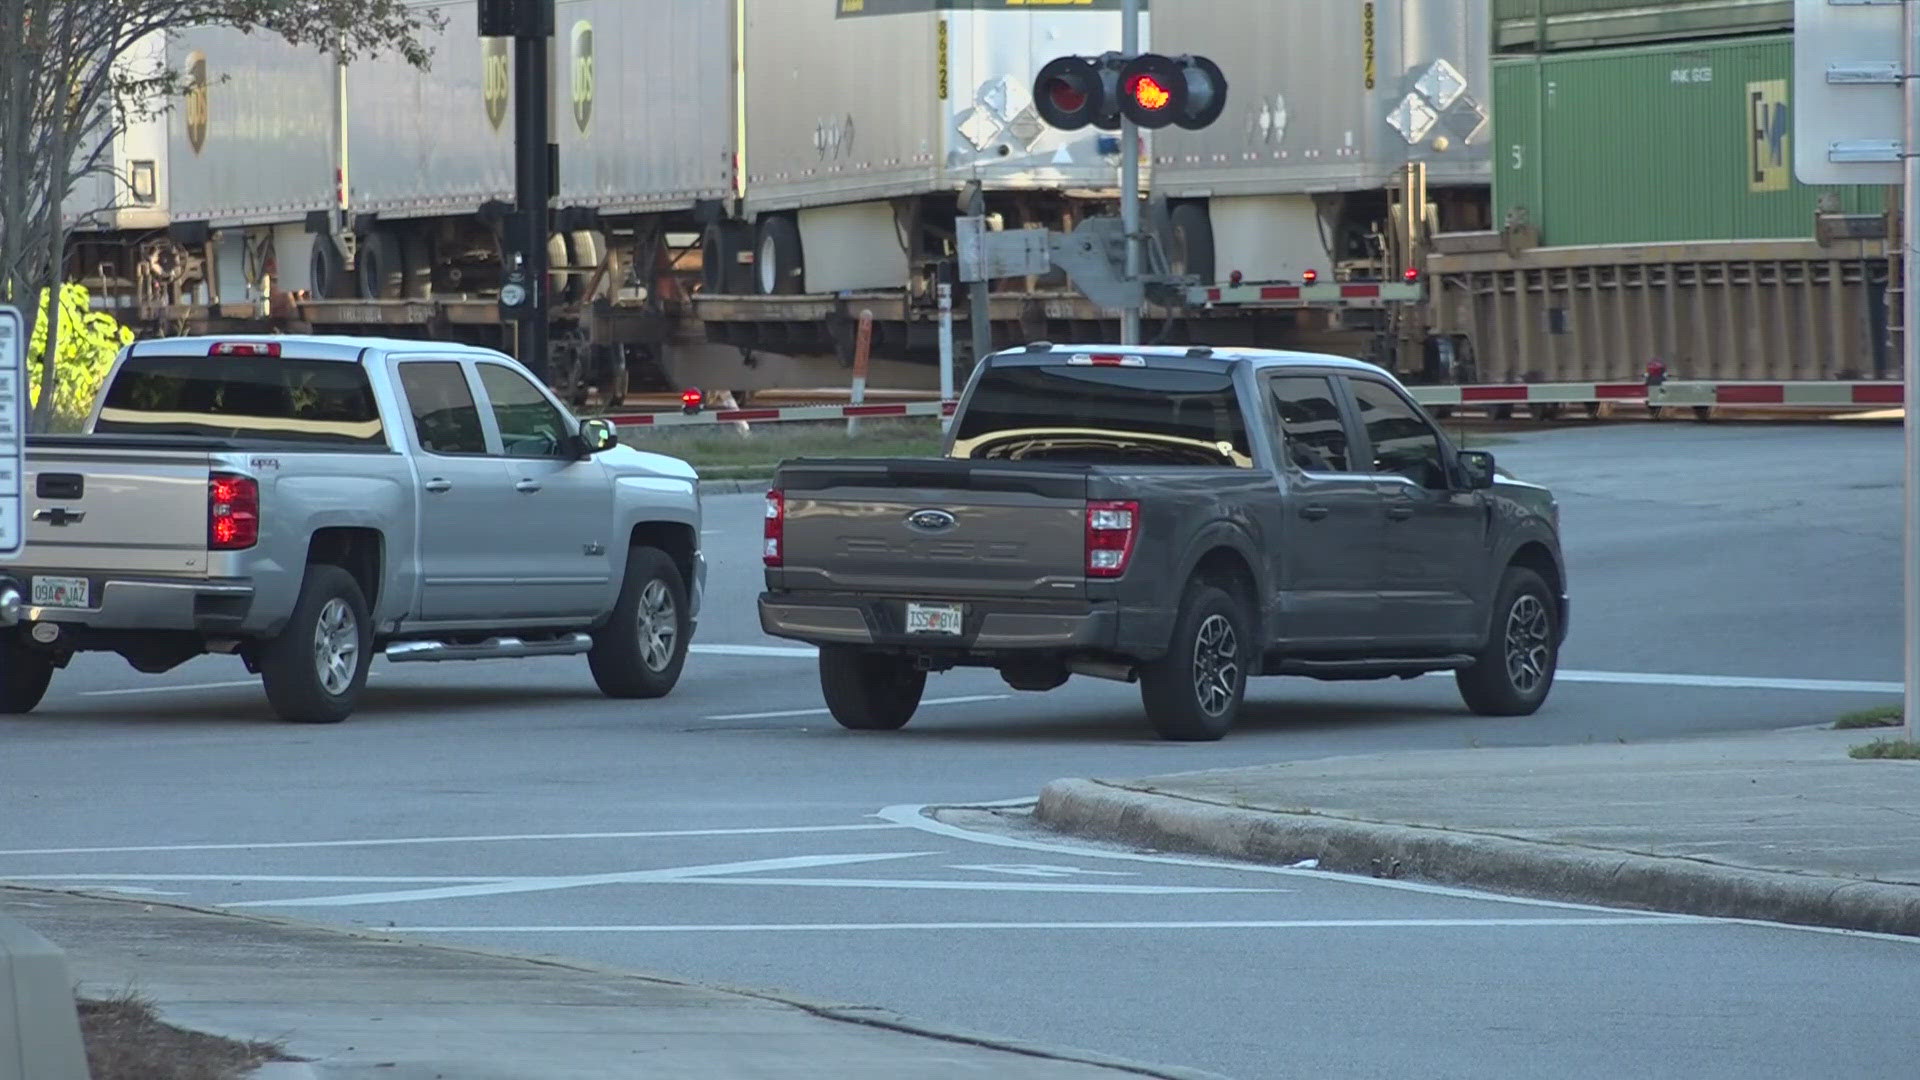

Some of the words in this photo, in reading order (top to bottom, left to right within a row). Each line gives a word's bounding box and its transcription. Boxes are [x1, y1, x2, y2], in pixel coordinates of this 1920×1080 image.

[1364, 2, 1374, 90] 88276
[484, 55, 508, 118] ups
[571, 55, 592, 121] ups
